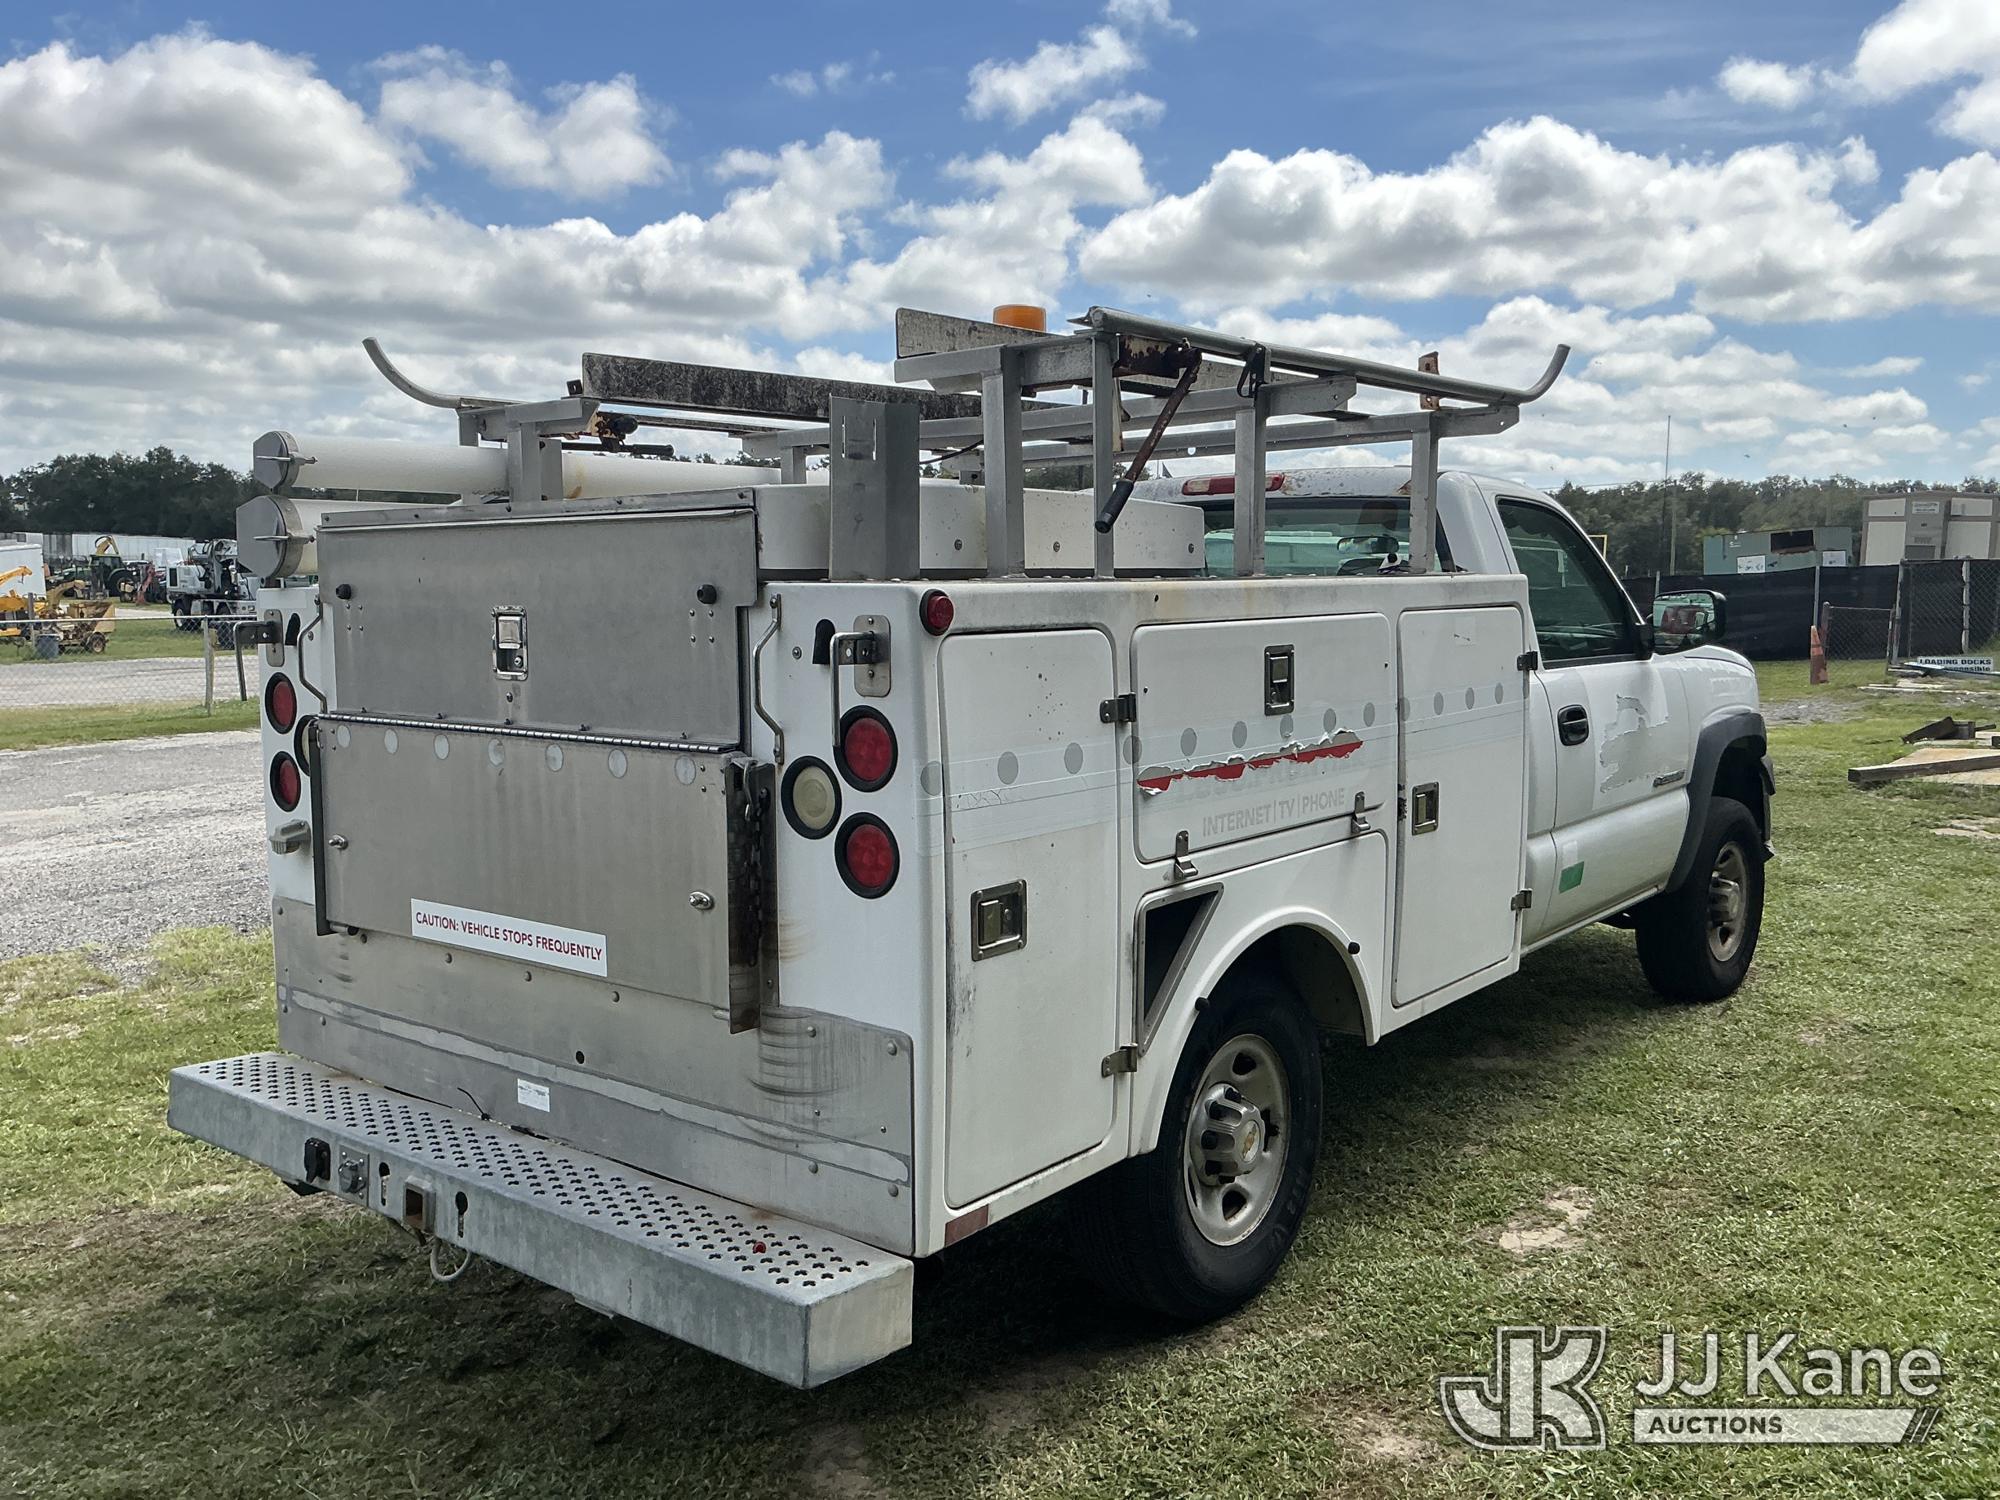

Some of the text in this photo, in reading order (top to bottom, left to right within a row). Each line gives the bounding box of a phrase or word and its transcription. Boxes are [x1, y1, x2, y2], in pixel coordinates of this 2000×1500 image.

[1202, 788, 1345, 837] INTERNET TV PHONE
[415, 911, 602, 961] CAUTION: VEHICLE STOPS FREQUENTLY
